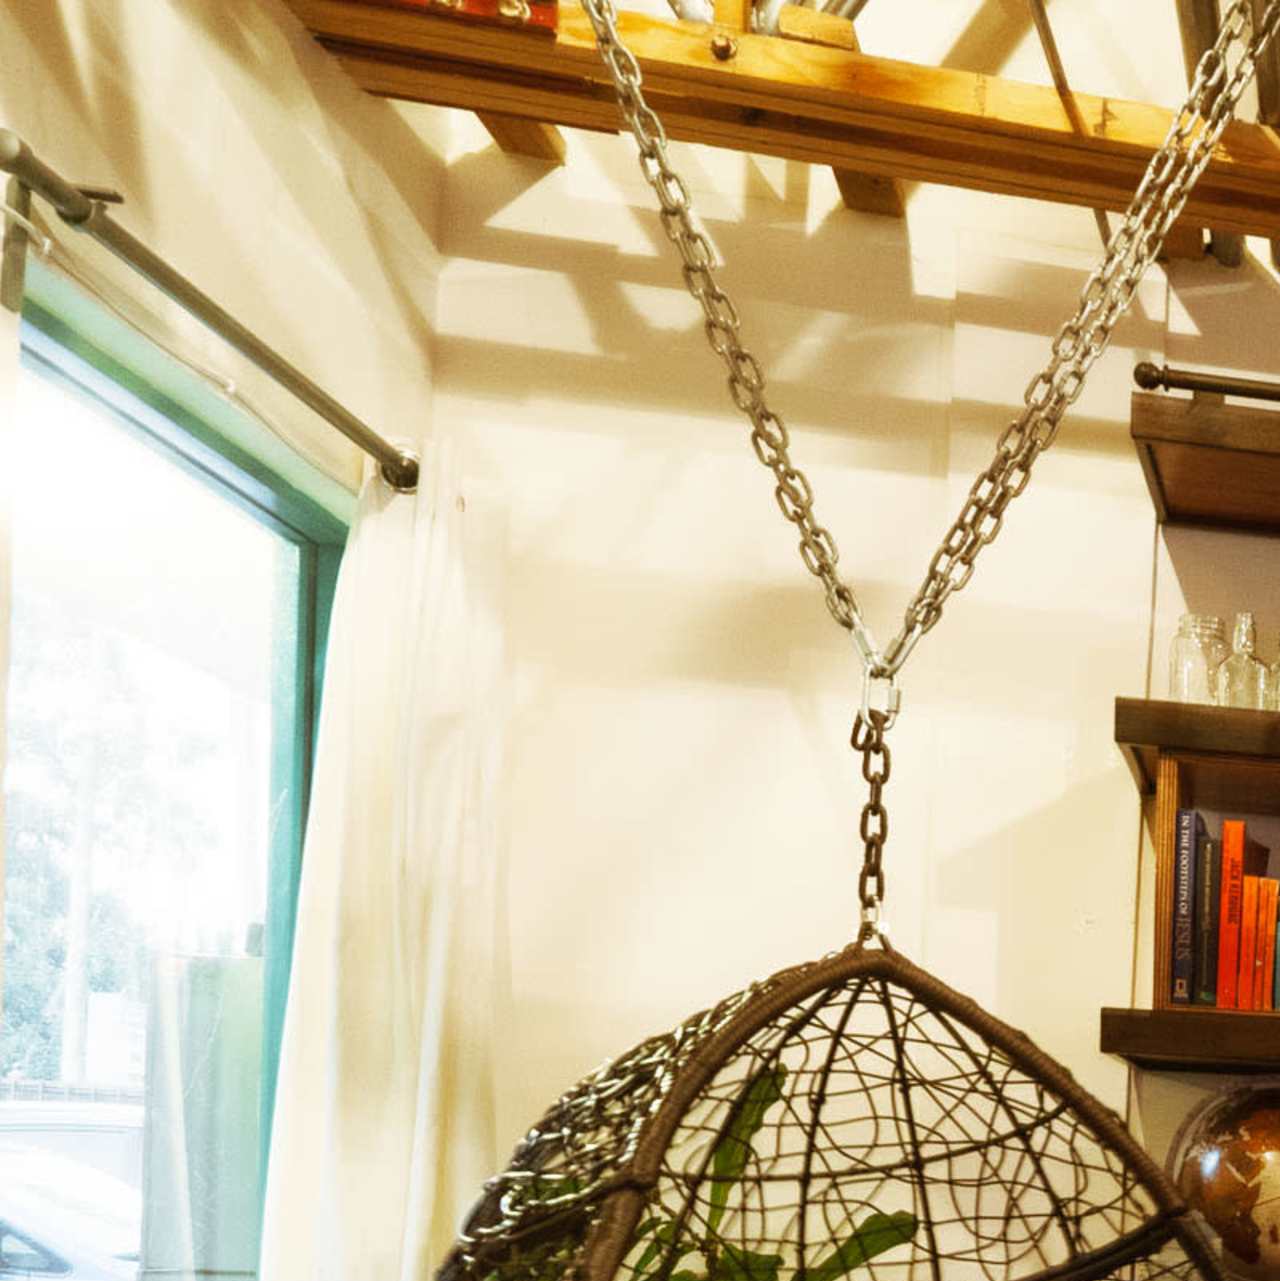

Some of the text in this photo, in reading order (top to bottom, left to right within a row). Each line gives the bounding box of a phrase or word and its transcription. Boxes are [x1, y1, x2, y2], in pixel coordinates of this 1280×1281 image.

[1175, 815, 1190, 960] IN THE FOOTSTEPS OF JESUS
